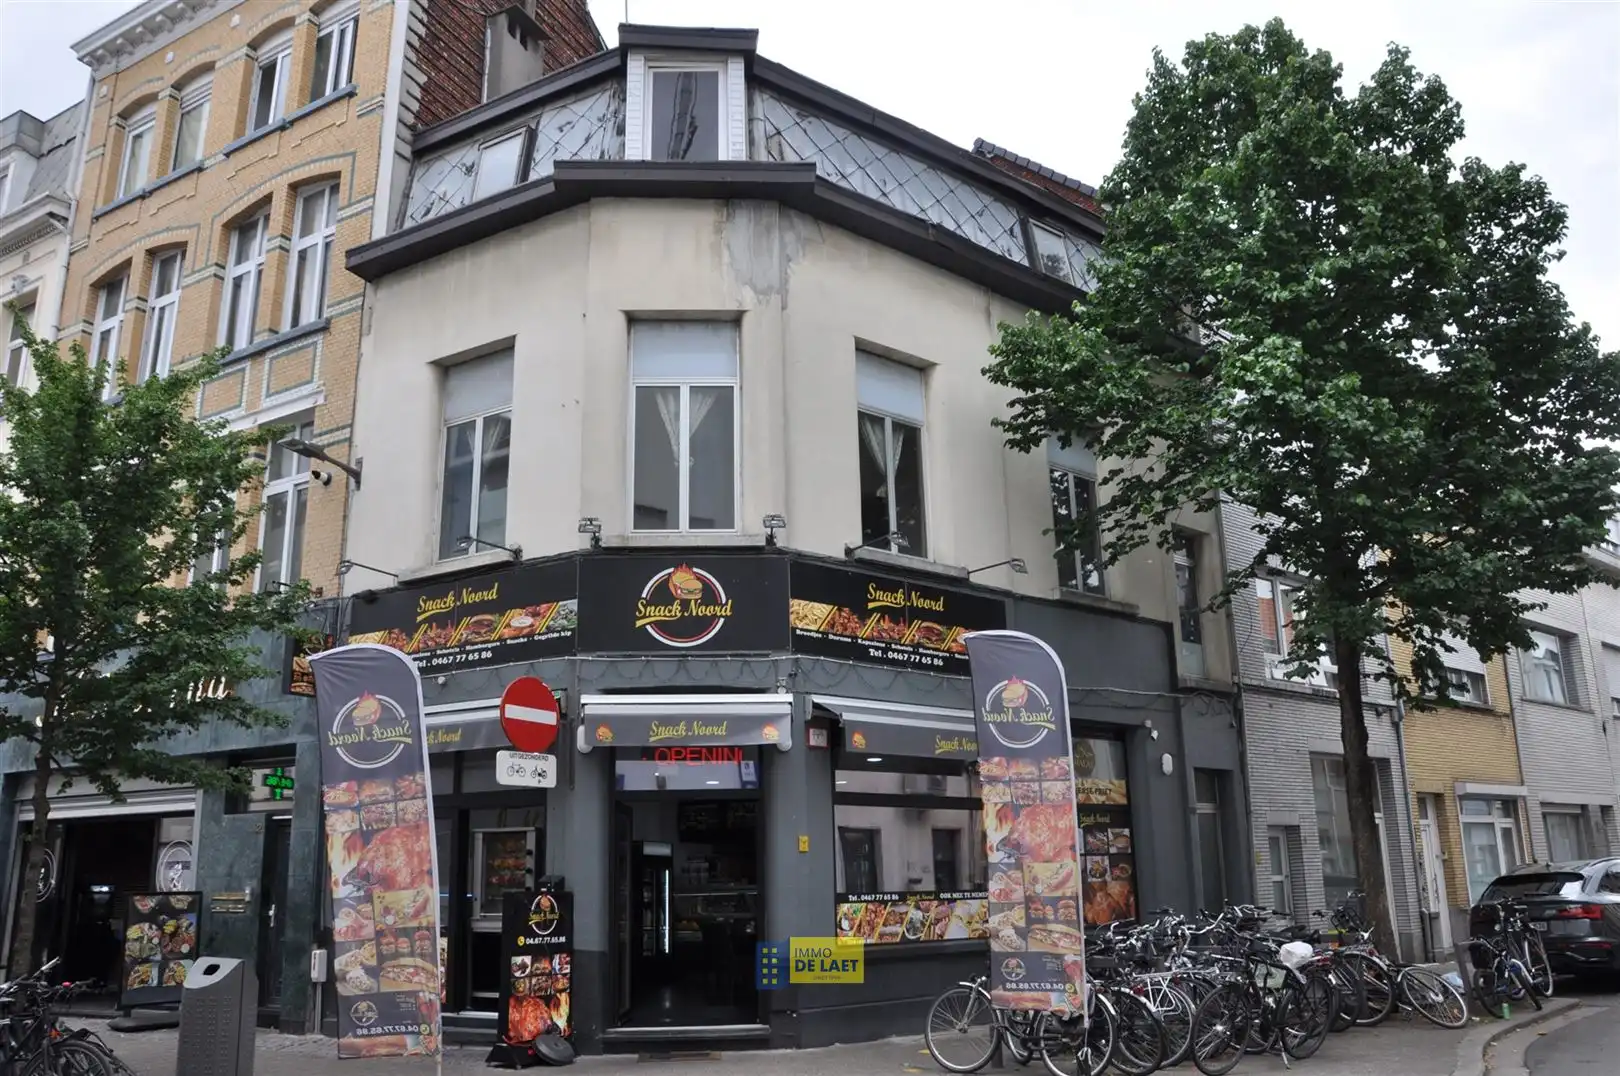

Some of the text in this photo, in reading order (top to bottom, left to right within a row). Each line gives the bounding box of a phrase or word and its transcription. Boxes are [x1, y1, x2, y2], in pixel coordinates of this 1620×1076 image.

[416, 582, 498, 622] Snack Noord
[867, 582, 944, 612] Snack Noord
[635, 599, 733, 628] Snack Noord
[432, 656, 453, 666] 0467
[455, 654, 466, 662] 77
[468, 652, 479, 661] 65
[481, 650, 493, 659] 86
[888, 651, 908, 661] 0467
[921, 656, 932, 665] 65
[933, 658, 944, 666] 86
[648, 721, 728, 742] Snack Noord
[935, 735, 959, 754] Snack
[509, 752, 549, 762] UITGEZONDERD
